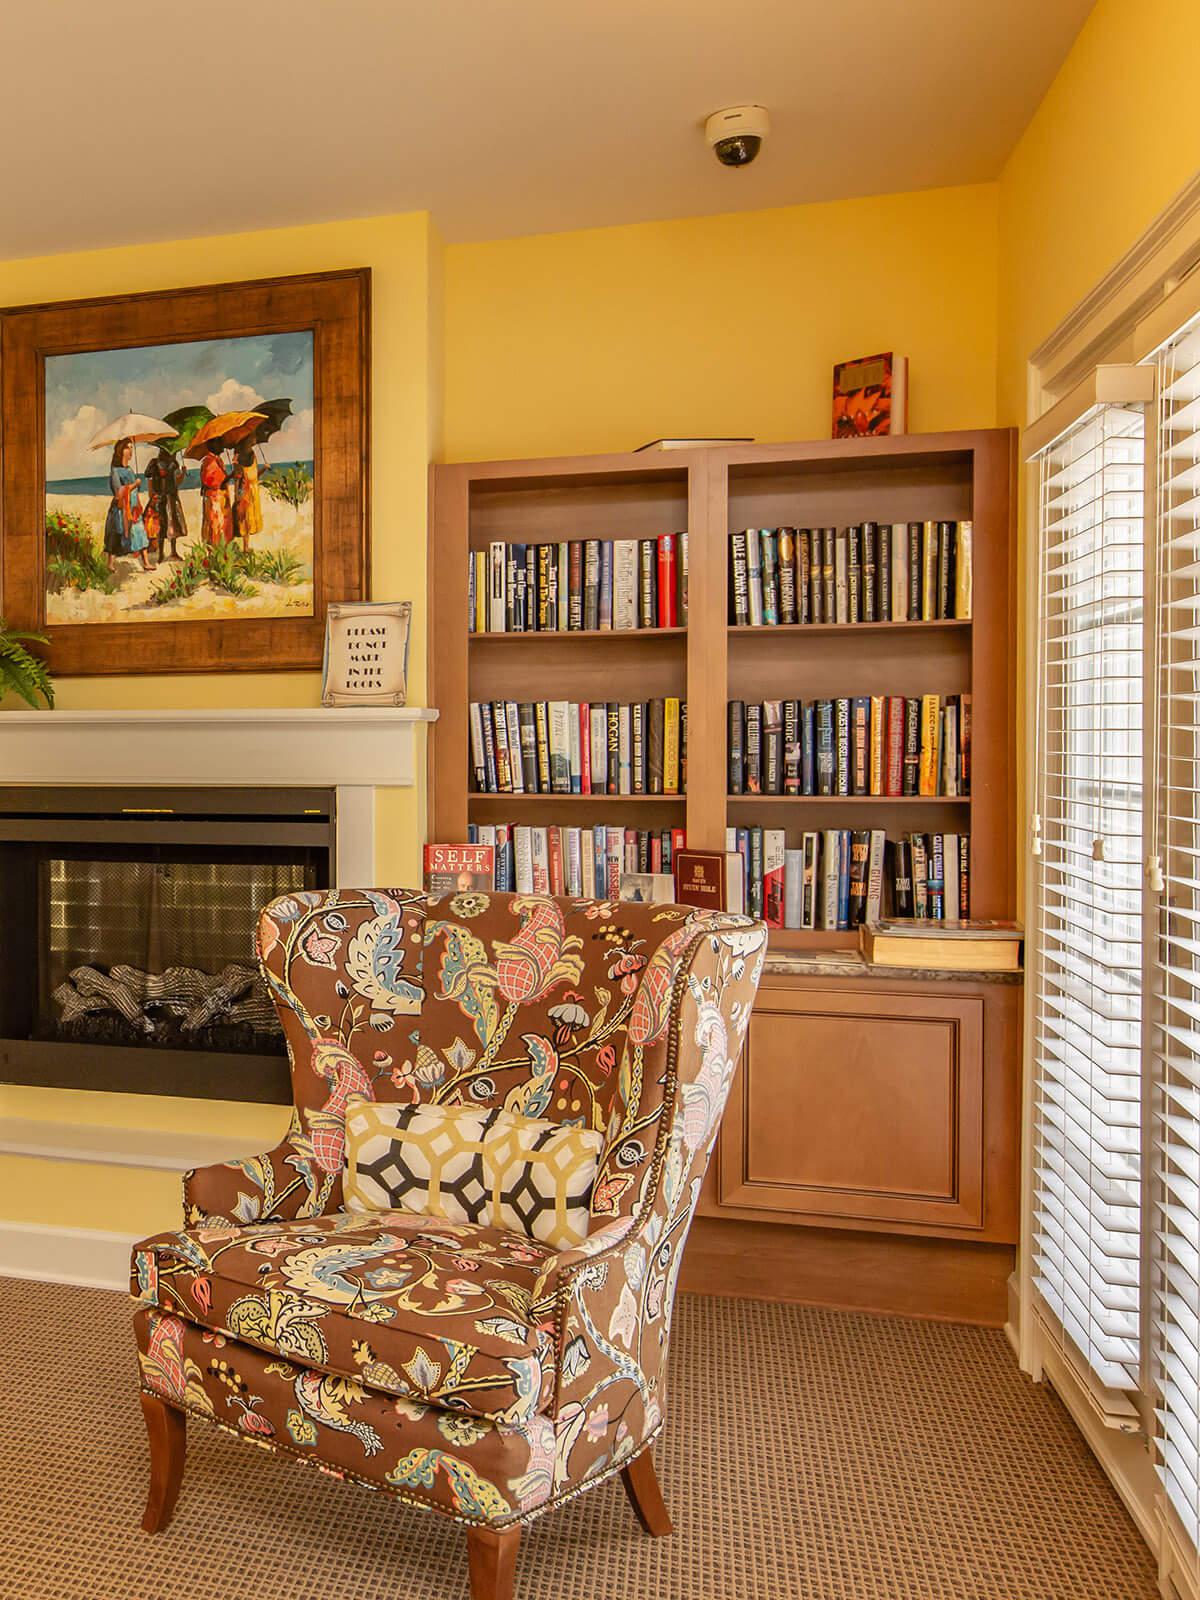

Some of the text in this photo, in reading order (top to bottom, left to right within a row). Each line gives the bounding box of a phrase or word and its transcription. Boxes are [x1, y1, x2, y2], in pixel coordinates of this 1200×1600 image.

[733, 535, 745, 558] DALE
[734, 560, 747, 594] BROWN
[781, 567, 794, 611] JOHN GRISHAM
[347, 627, 386, 635] PLEASE
[366, 641, 386, 649] NOT
[747, 706, 760, 720] FAYE
[839, 699, 848, 712] POP
[509, 710, 518, 729] Which
[785, 702, 798, 742] malone
[839, 712, 848, 726] GOES
[908, 700, 918, 752] PEACEMAKER
[608, 712, 618, 752] HOGAN
[839, 727, 848, 737] THE
[933, 835, 942, 853] CLIVE
[435, 850, 486, 863] SELF
[430, 863, 490, 872] MATTERS
[870, 869, 880, 900] GIVING
